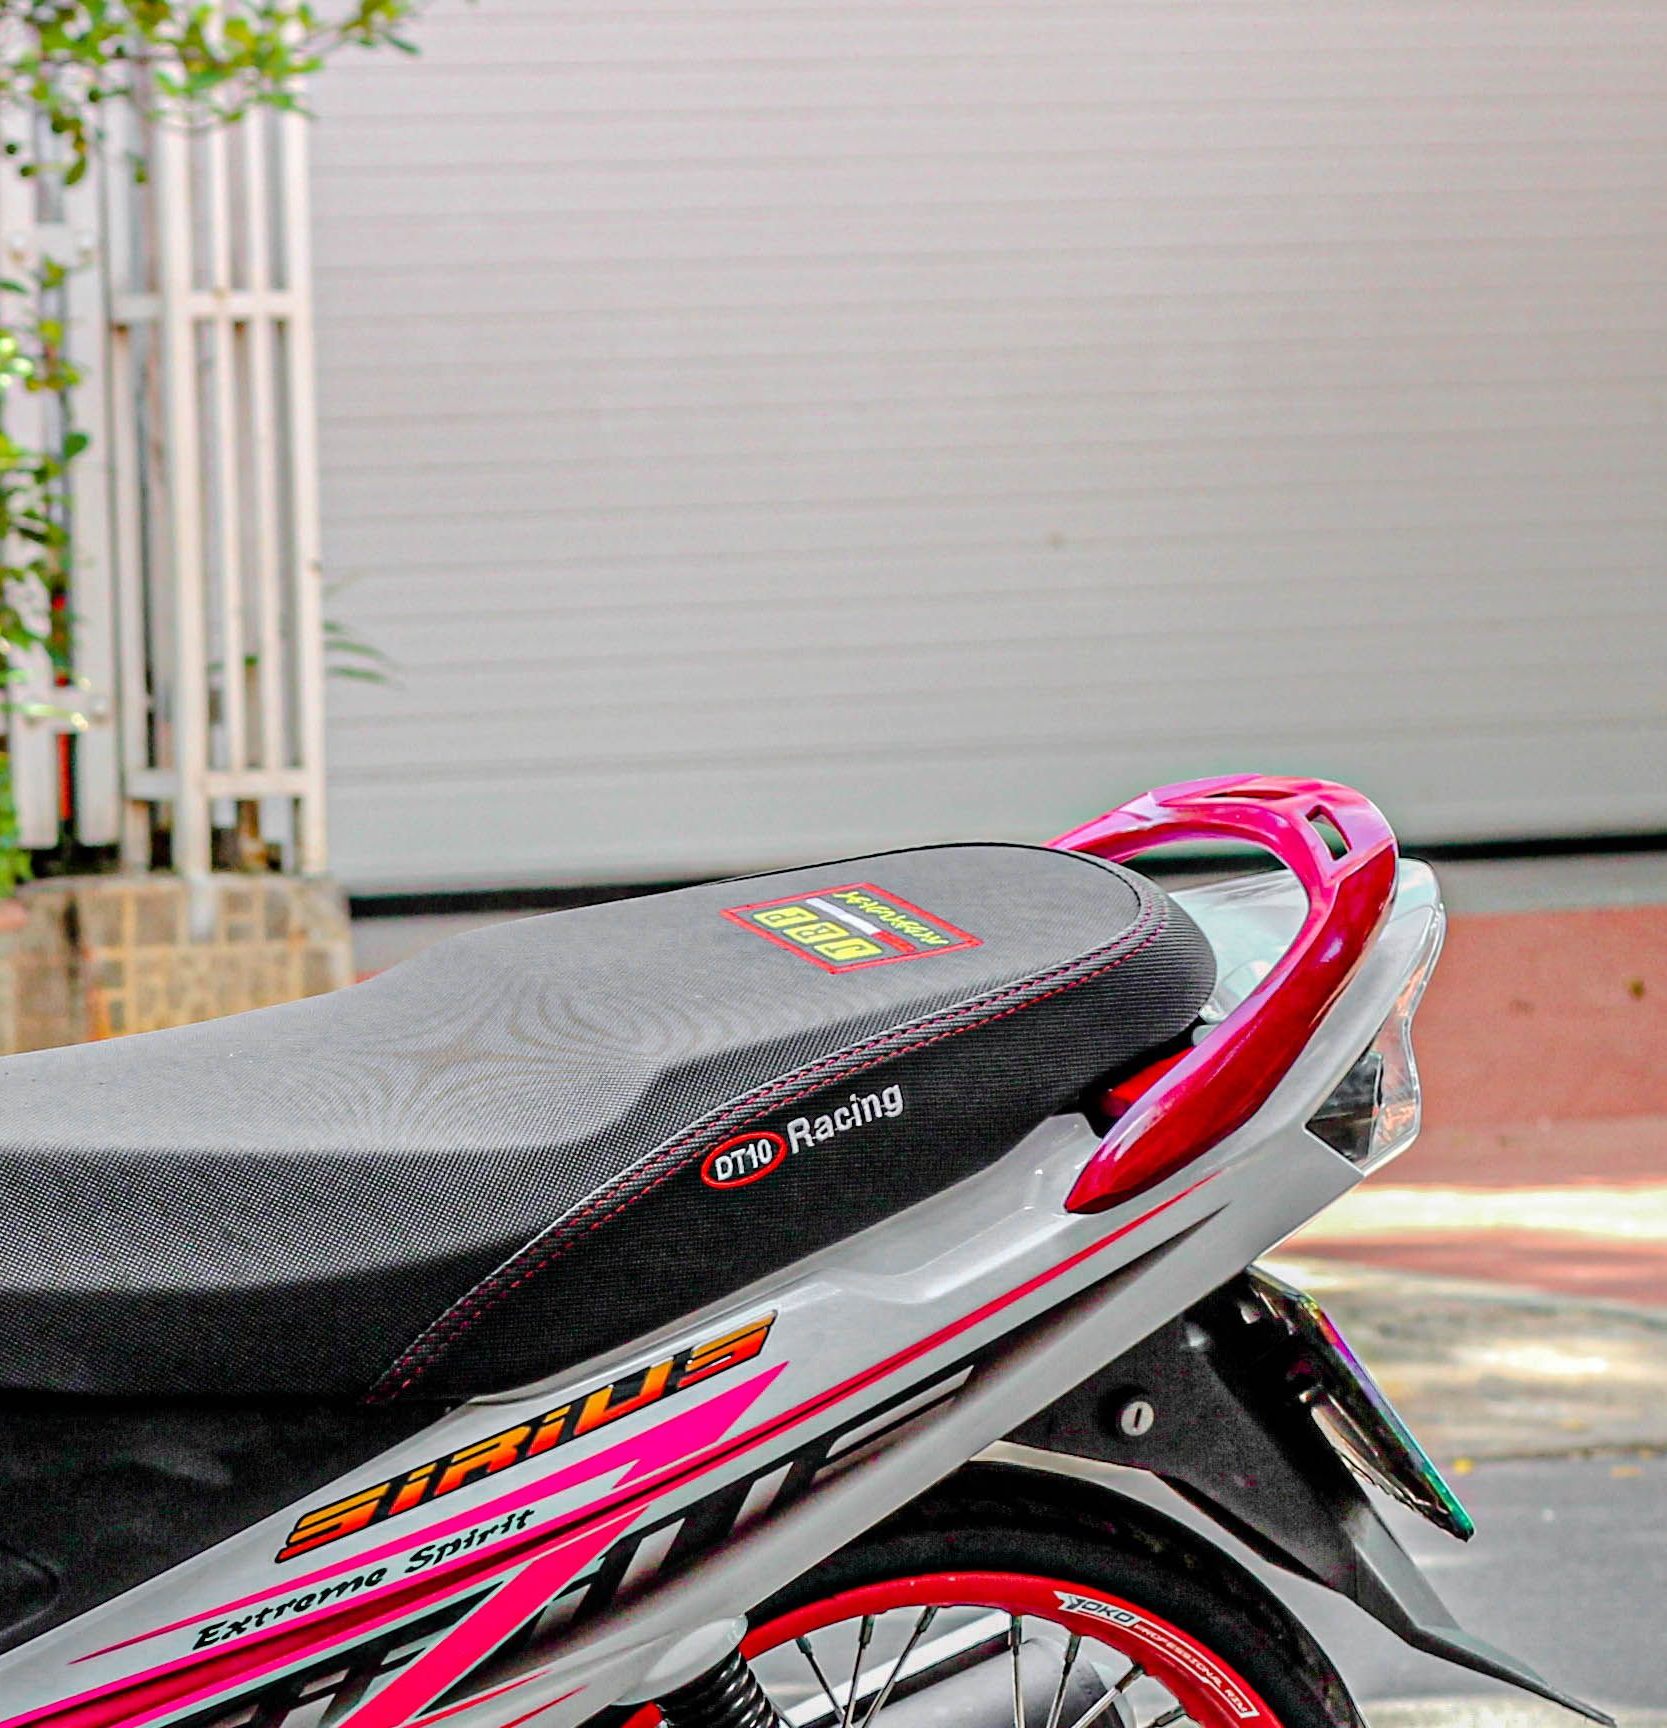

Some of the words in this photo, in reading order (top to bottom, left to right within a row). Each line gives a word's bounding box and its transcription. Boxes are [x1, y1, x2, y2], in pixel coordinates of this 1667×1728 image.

[714, 1138, 773, 1182] DT10
[786, 1085, 905, 1153] Racing
[192, 1566, 386, 1651] Extreme
[404, 1506, 535, 1576] Spirit
[1067, 1595, 1135, 1623] YOKO
[1134, 1624, 1222, 1688] PROFESSIONAL
[1225, 1689, 1247, 1713] RIM
